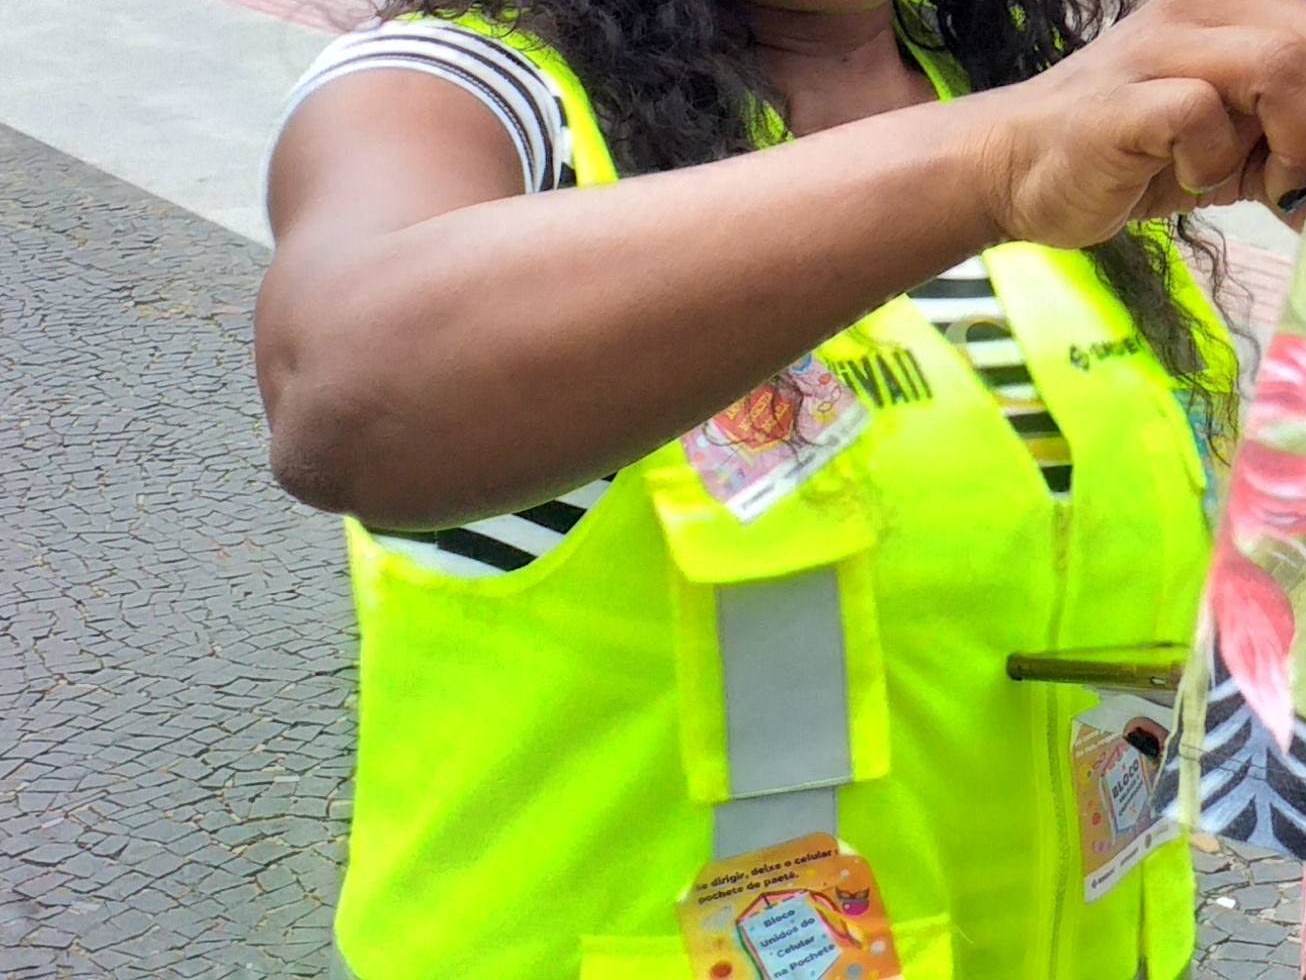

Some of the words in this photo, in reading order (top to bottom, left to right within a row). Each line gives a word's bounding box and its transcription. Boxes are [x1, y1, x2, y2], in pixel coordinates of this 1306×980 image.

[1112, 759, 1140, 799] BLOCO
[710, 870, 749, 888] dirigir,
[750, 862, 781, 877] deixe
[793, 849, 833, 865] celular
[698, 886, 744, 905] pochete
[746, 879, 761, 890] de
[759, 926, 799, 948] Unidos
[800, 917, 816, 929] do
[763, 909, 796, 928] Bloco
[773, 968, 789, 979] na
[789, 943, 836, 971] Pochete
[776, 934, 816, 958] Celular
